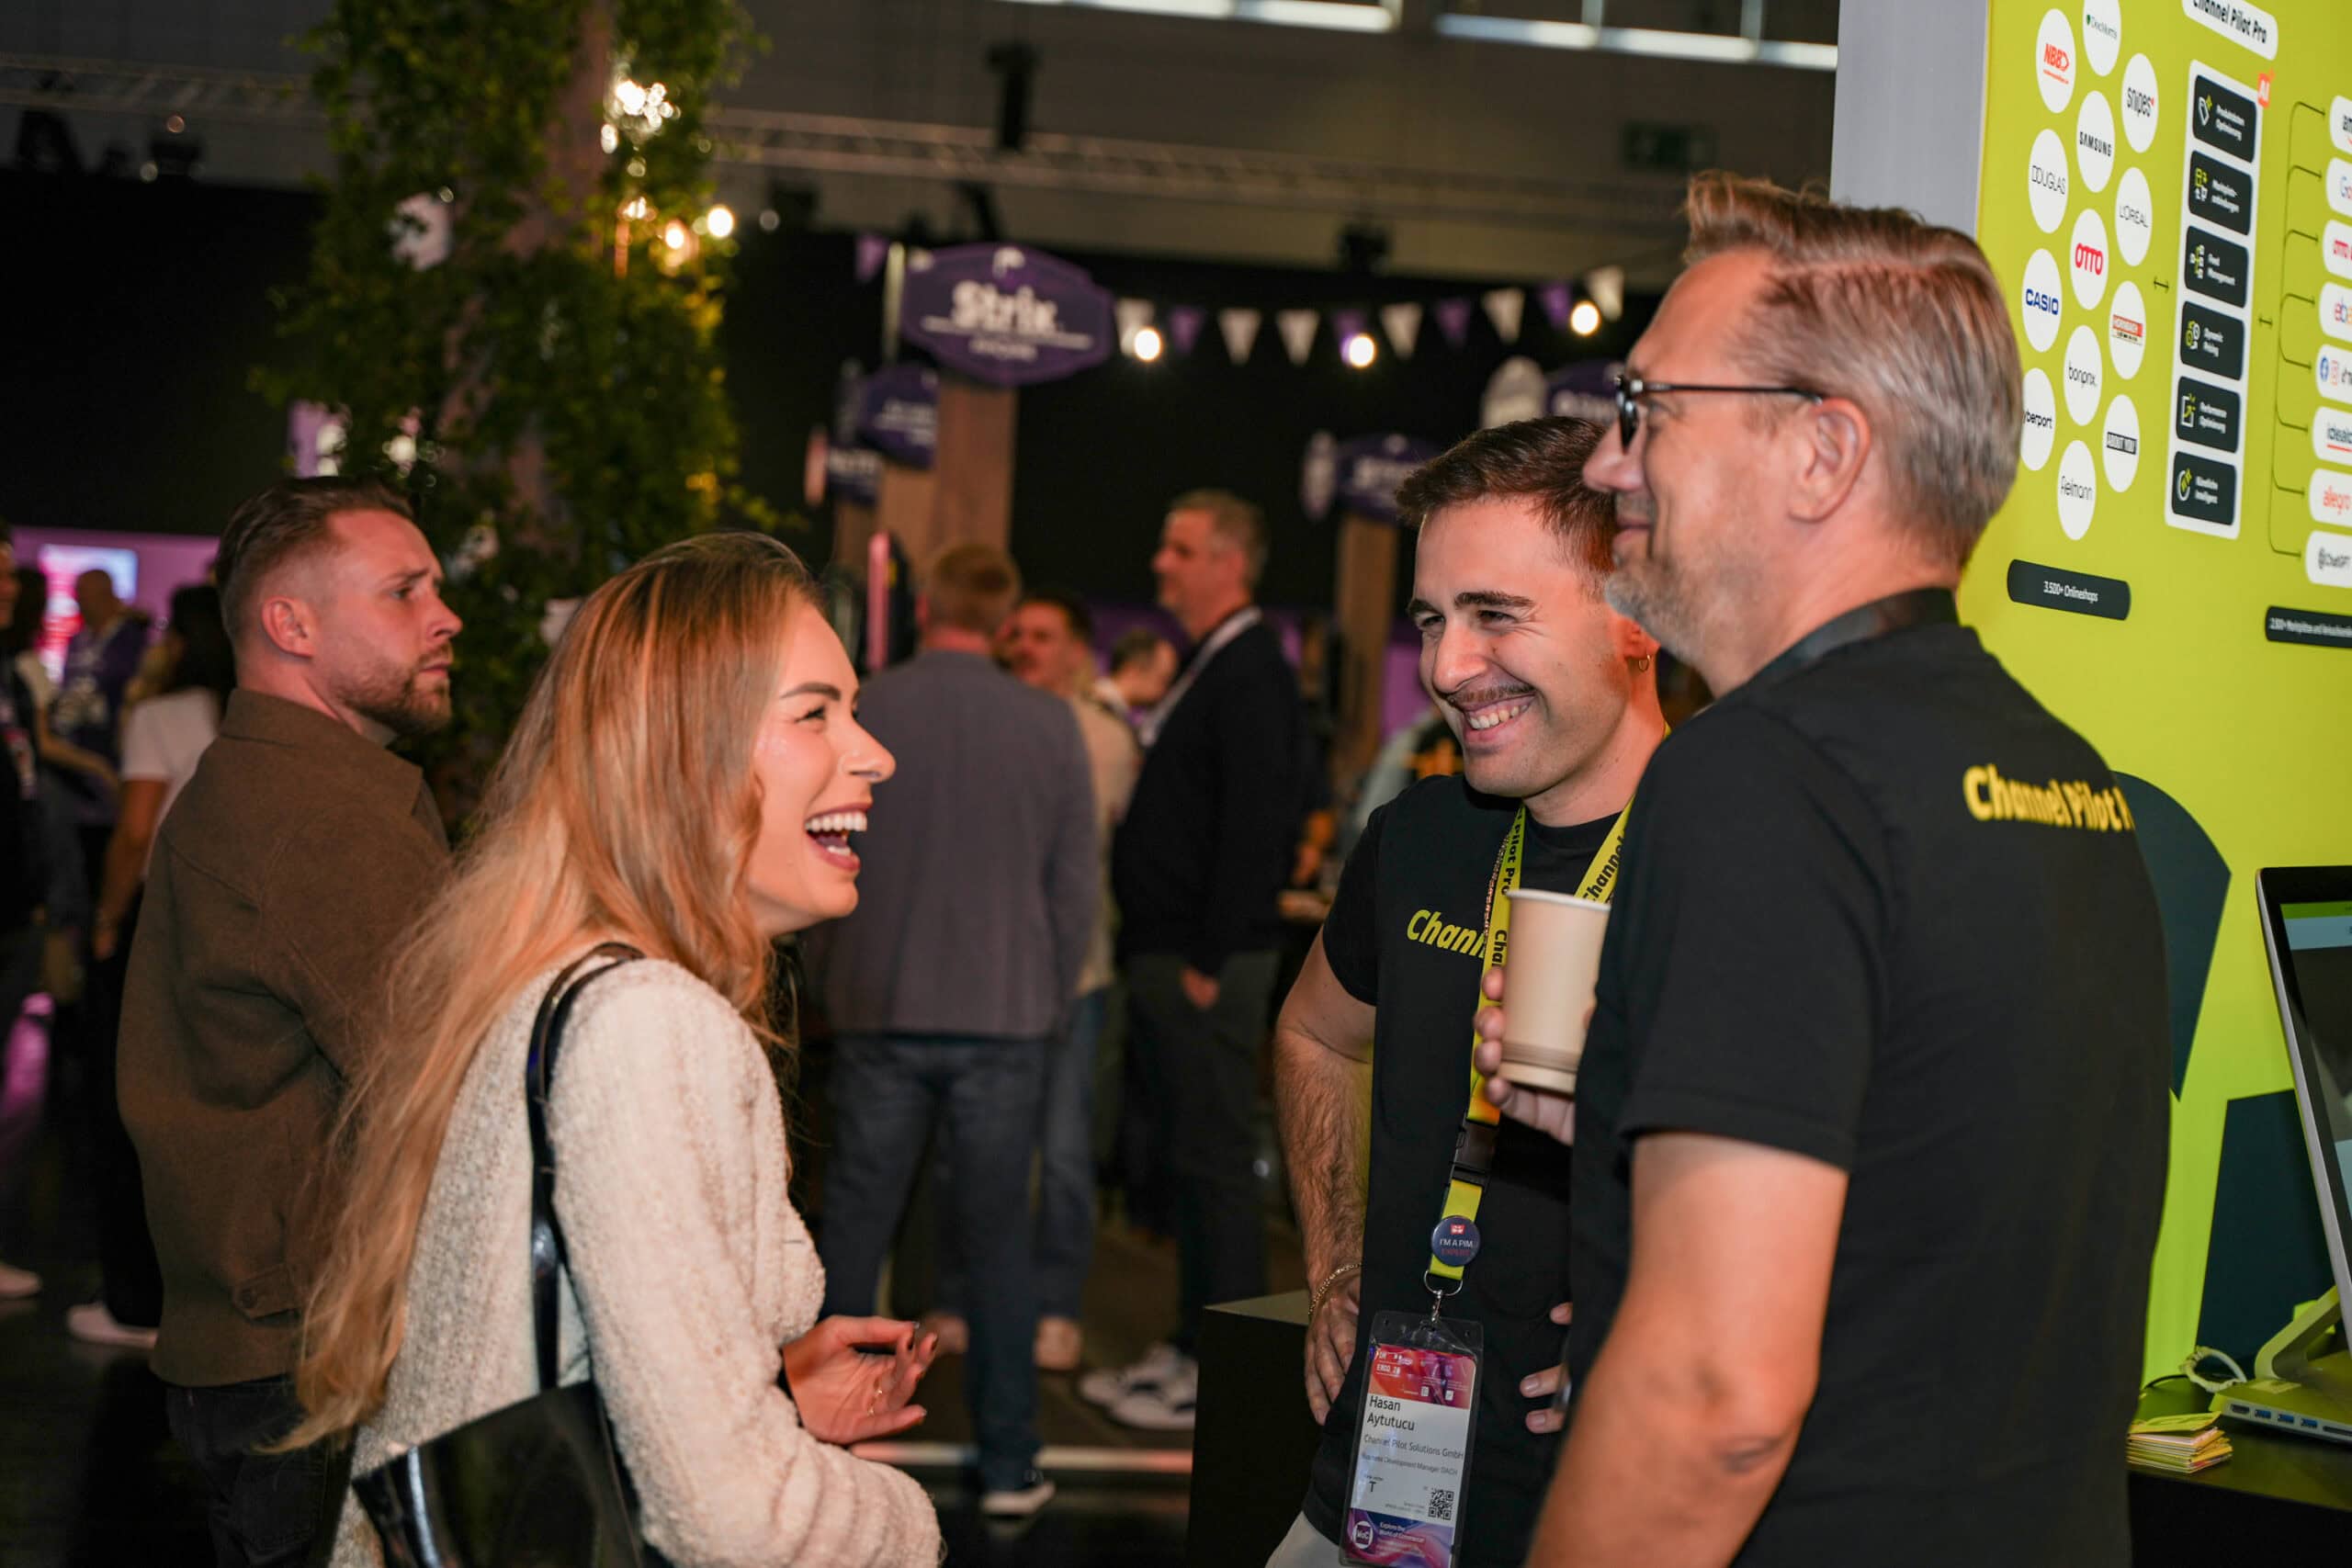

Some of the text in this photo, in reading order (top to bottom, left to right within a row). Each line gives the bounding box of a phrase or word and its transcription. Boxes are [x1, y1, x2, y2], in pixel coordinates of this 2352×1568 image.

[2230, 7, 2251, 35] Pilot
[2251, 20, 2267, 43] Pro
[2044, 43, 2064, 70] NBB
[2127, 87, 2152, 118] snipes
[2078, 131, 2112, 157] SAMSUNG
[2030, 164, 2066, 195] DOUGLAS
[2075, 243, 2104, 276] OTTO
[2025, 288, 2059, 315] CASIO
[2022, 409, 2052, 430] yberport
[2064, 585, 2098, 604] Onlineshops
[1962, 763, 2073, 827] Channel
[1583, 835, 1624, 901] hannel
[1407, 909, 1486, 958] Chann
[1369, 1395, 1401, 1411] Hasan
[1367, 1413, 1415, 1430] Aytutucu
[1392, 1438, 1407, 1450] Pilot
[1409, 1441, 1441, 1456] Solutions
[1442, 1448, 1464, 1460] GmbH
[1368, 1480, 1376, 1493] T
